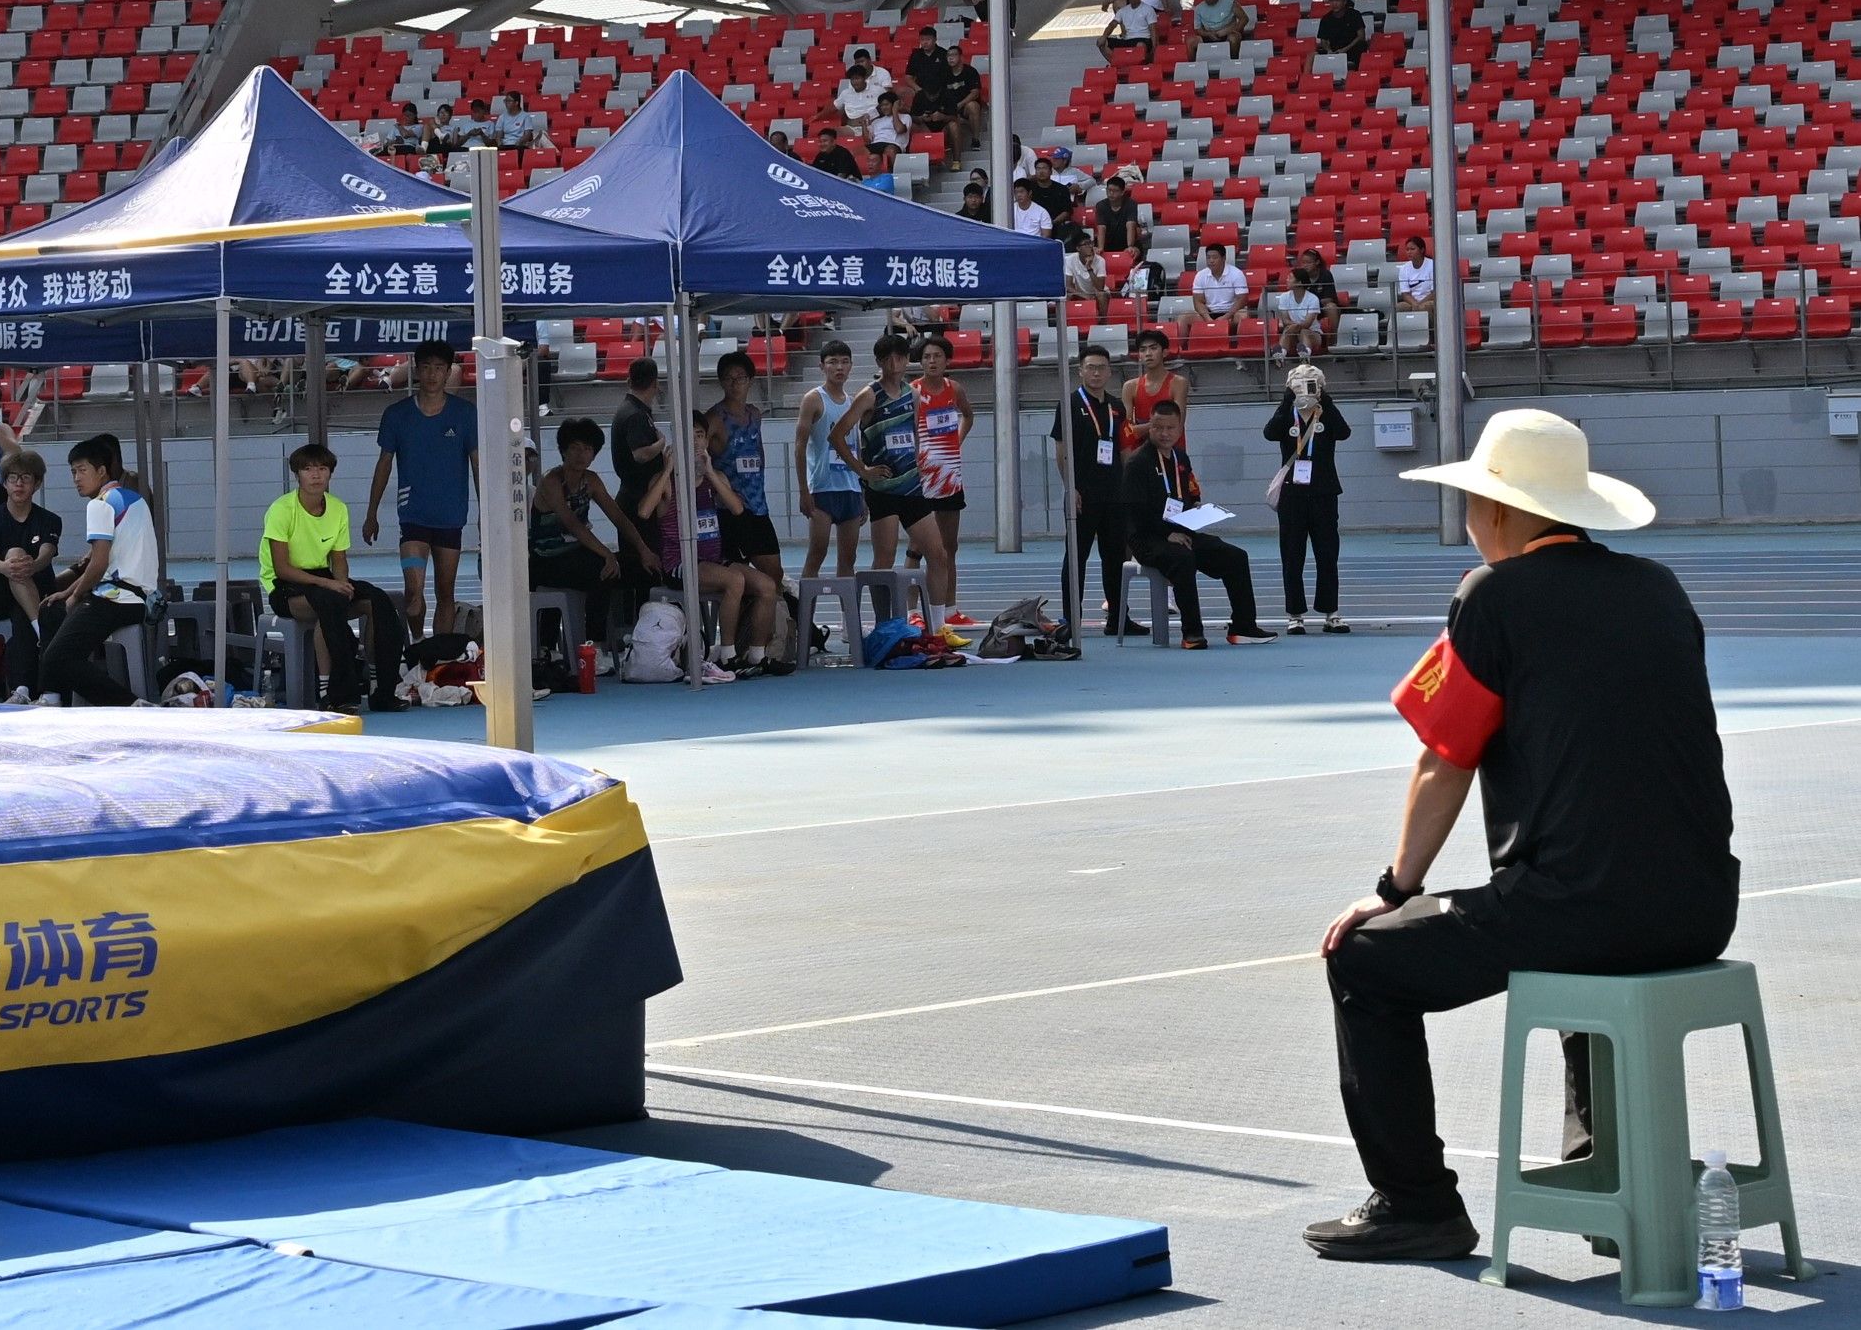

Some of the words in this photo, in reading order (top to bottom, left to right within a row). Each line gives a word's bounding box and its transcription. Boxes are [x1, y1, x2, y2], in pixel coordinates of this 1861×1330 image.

[41, 268, 133, 307] 我选移动
[324, 262, 439, 296] 全心全意
[767, 254, 865, 287] 全心全意
[886, 255, 980, 289] 为您服务
